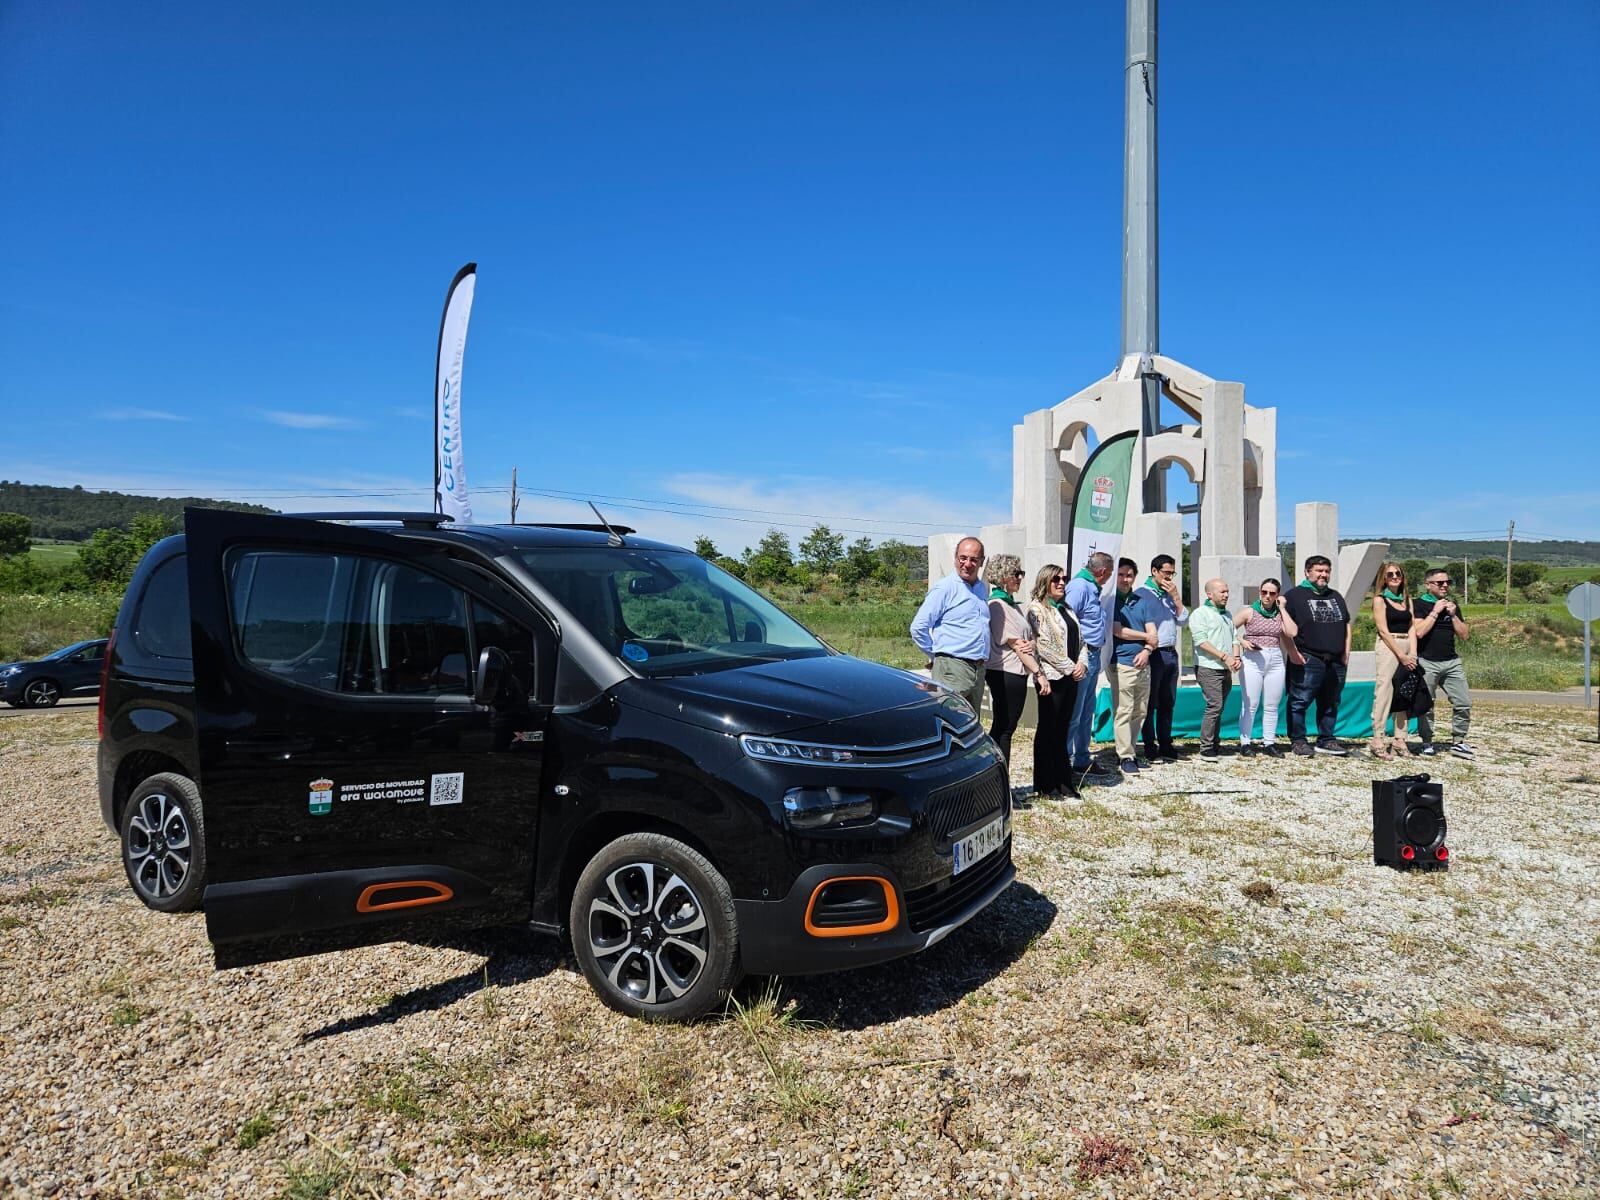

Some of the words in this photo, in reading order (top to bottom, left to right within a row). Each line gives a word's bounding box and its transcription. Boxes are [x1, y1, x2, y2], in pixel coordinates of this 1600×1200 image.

[341, 783, 375, 792] SERVICIO
[386, 779, 425, 788] MOVILIDAD
[340, 792, 360, 802] era
[363, 788, 425, 800] walamove
